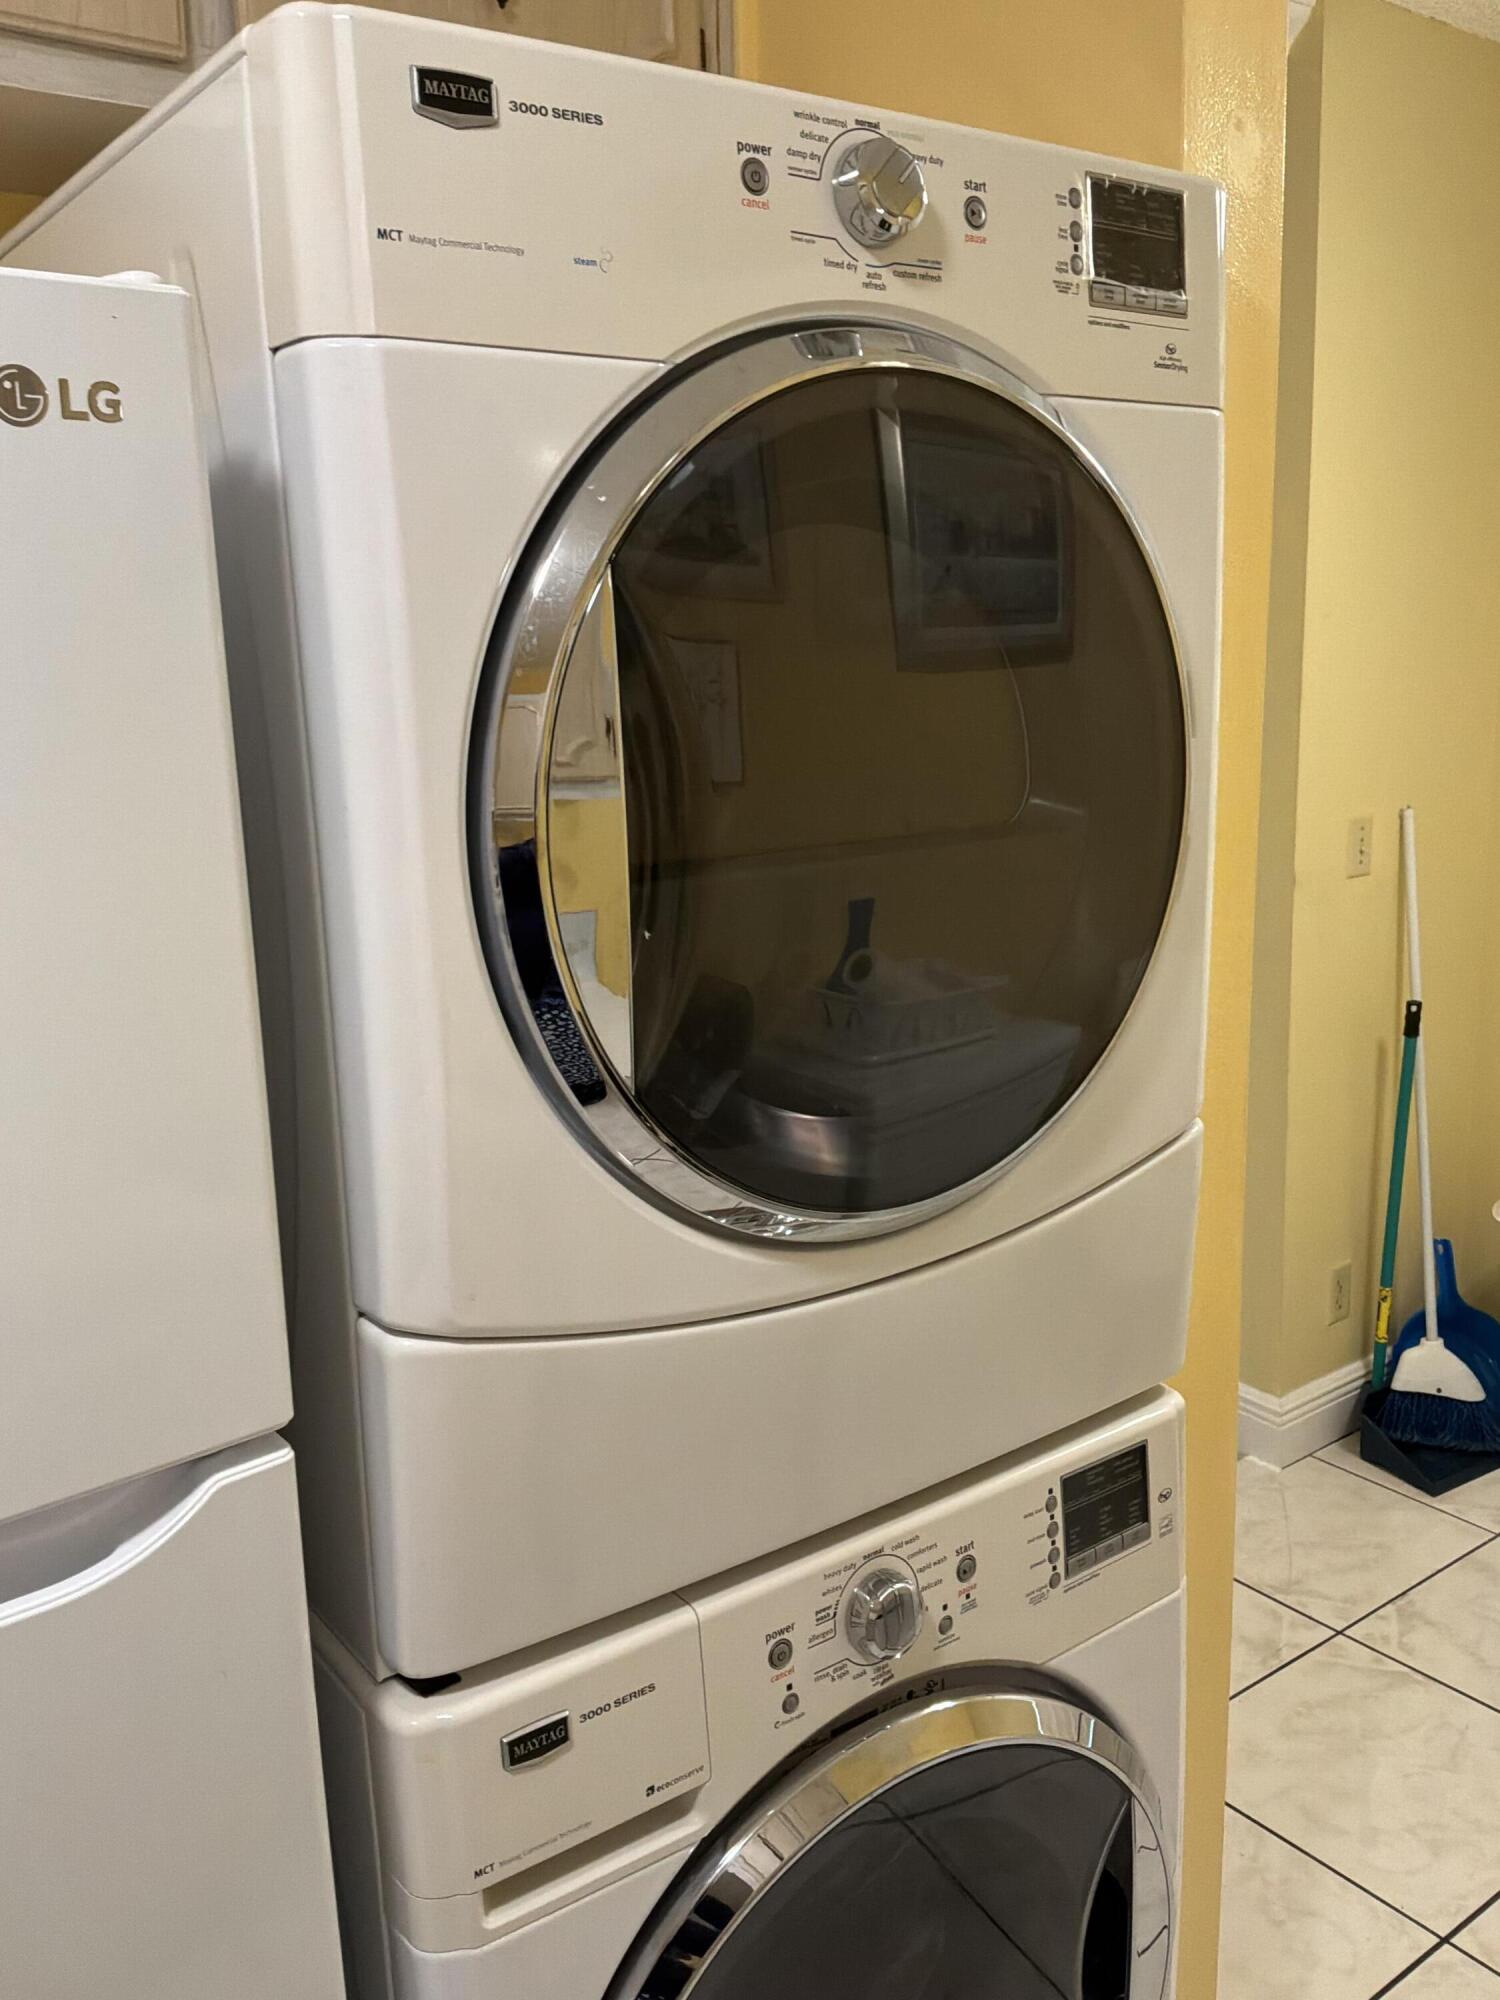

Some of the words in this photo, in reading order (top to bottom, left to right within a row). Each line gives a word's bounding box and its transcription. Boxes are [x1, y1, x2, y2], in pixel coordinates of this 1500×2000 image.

[424, 79, 489, 104] MAYTAG
[508, 100, 549, 117] 3000
[552, 107, 603, 126] SERIES
[794, 111, 820, 123] wrinkle
[822, 117, 848, 128] control
[854, 118, 880, 130] normal
[800, 130, 829, 144] delicate
[737, 141, 772, 156] power
[786, 147, 808, 160] damp
[808, 151, 821, 163] dry
[964, 179, 986, 193] start
[742, 198, 769, 210] cancel
[377, 228, 403, 242] MCT
[573, 257, 598, 266] steam
[824, 258, 845, 270] timed
[846, 261, 858, 274] dry
[865, 271, 883, 281] auto
[892, 269, 917, 280] custom
[918, 271, 943, 283] refresh
[862, 281, 887, 292] refresh
[58, 378, 123, 423] LG
[863, 1546, 884, 1560] normal
[891, 1541, 904, 1552] cold
[956, 1540, 975, 1557] start
[843, 1562, 857, 1574] duty
[765, 1622, 796, 1645] power
[808, 1628, 834, 1644] allergen
[770, 1664, 795, 1683] cancel
[579, 1703, 612, 1724] 3000
[614, 1683, 656, 1708] SERIES
[513, 1724, 566, 1759] MAYTAG
[474, 1862, 495, 1880] MCT
